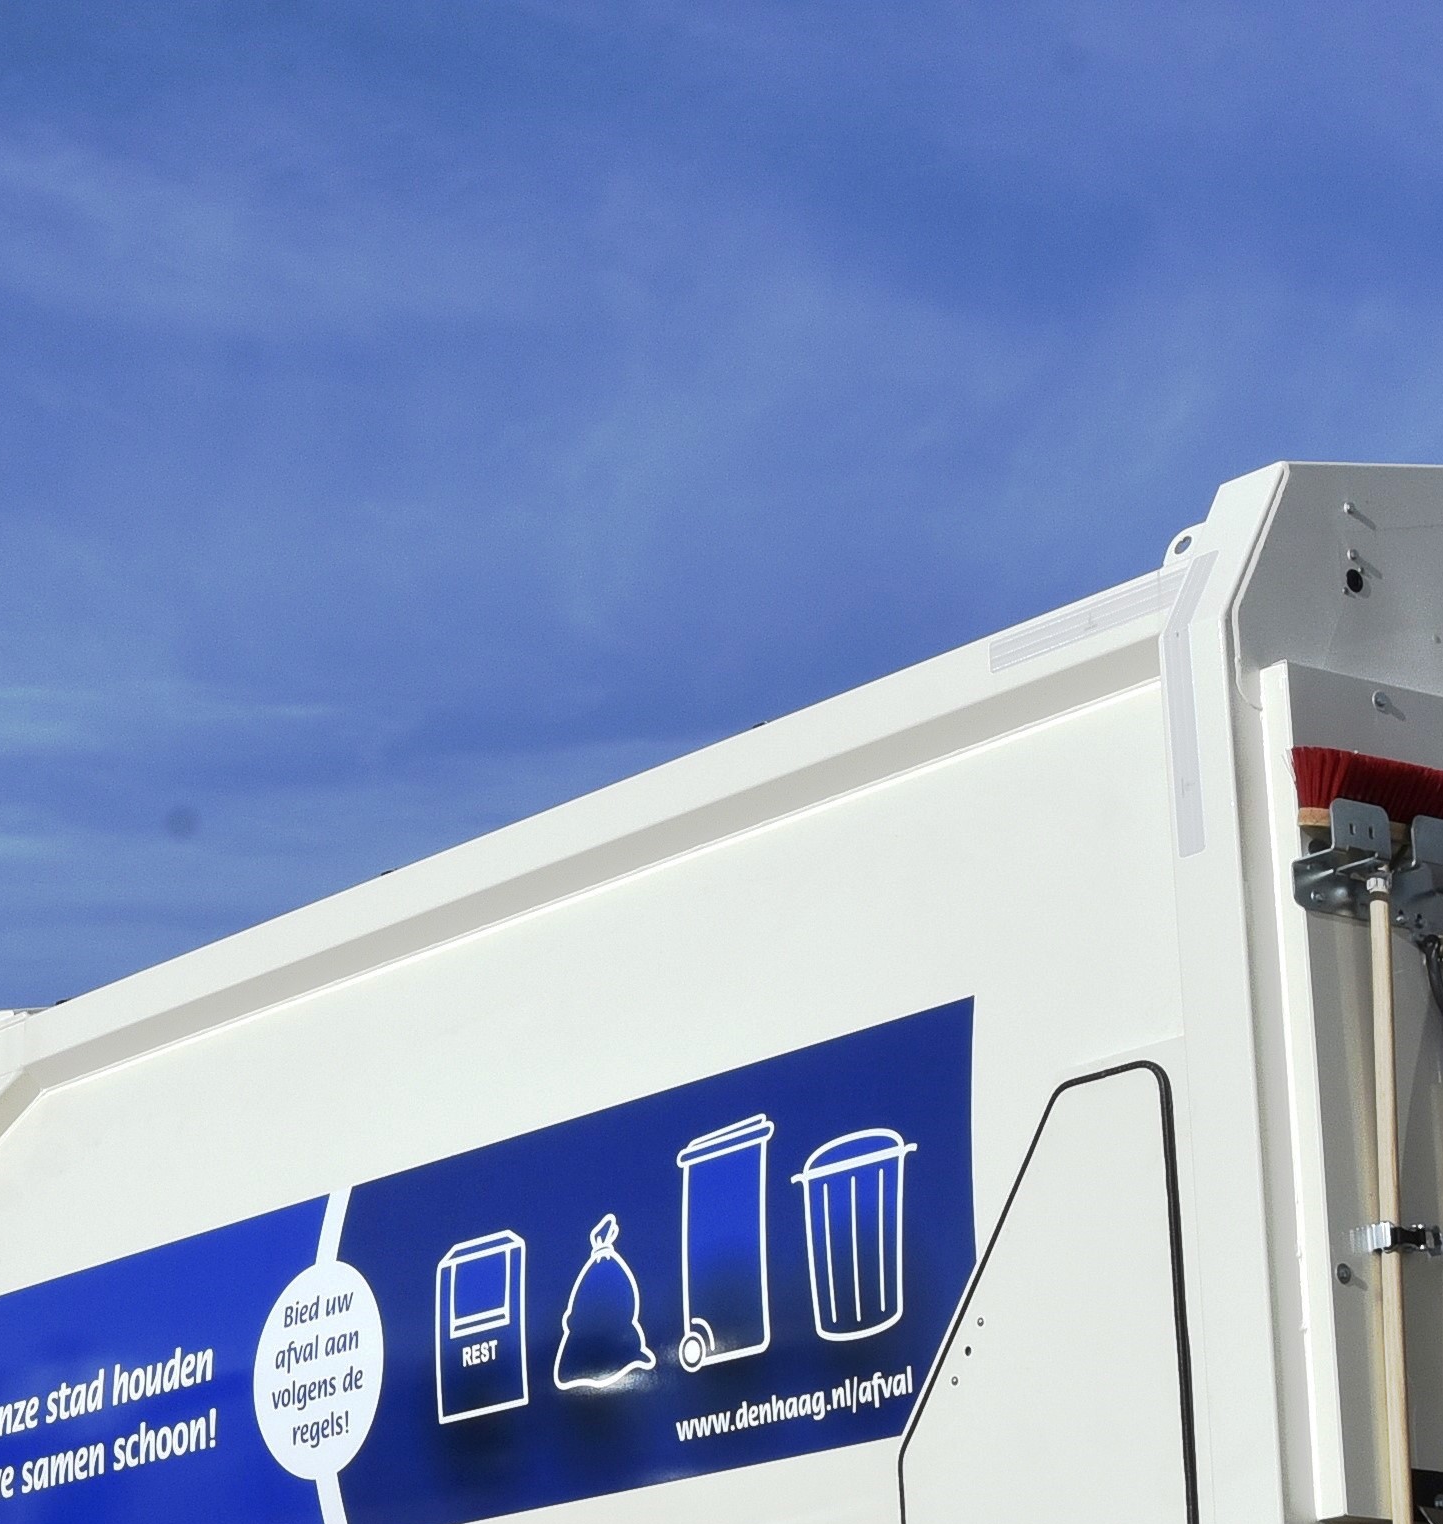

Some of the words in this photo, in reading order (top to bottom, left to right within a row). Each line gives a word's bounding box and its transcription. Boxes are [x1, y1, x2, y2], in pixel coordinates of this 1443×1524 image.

[282, 1300, 320, 1328] Bied
[325, 1291, 354, 1317] uw
[275, 1338, 319, 1373] afval
[324, 1330, 359, 1357] aan
[462, 1339, 498, 1368] REST
[45, 1367, 105, 1424] stad
[112, 1346, 214, 1402] houden
[271, 1377, 337, 1413] volgens
[342, 1366, 364, 1393] de
[676, 1366, 914, 1442] www.denhaag.nl/afval
[21, 1442, 105, 1494] samen
[113, 1407, 217, 1471] schoon!
[292, 1411, 349, 1449] regels!
